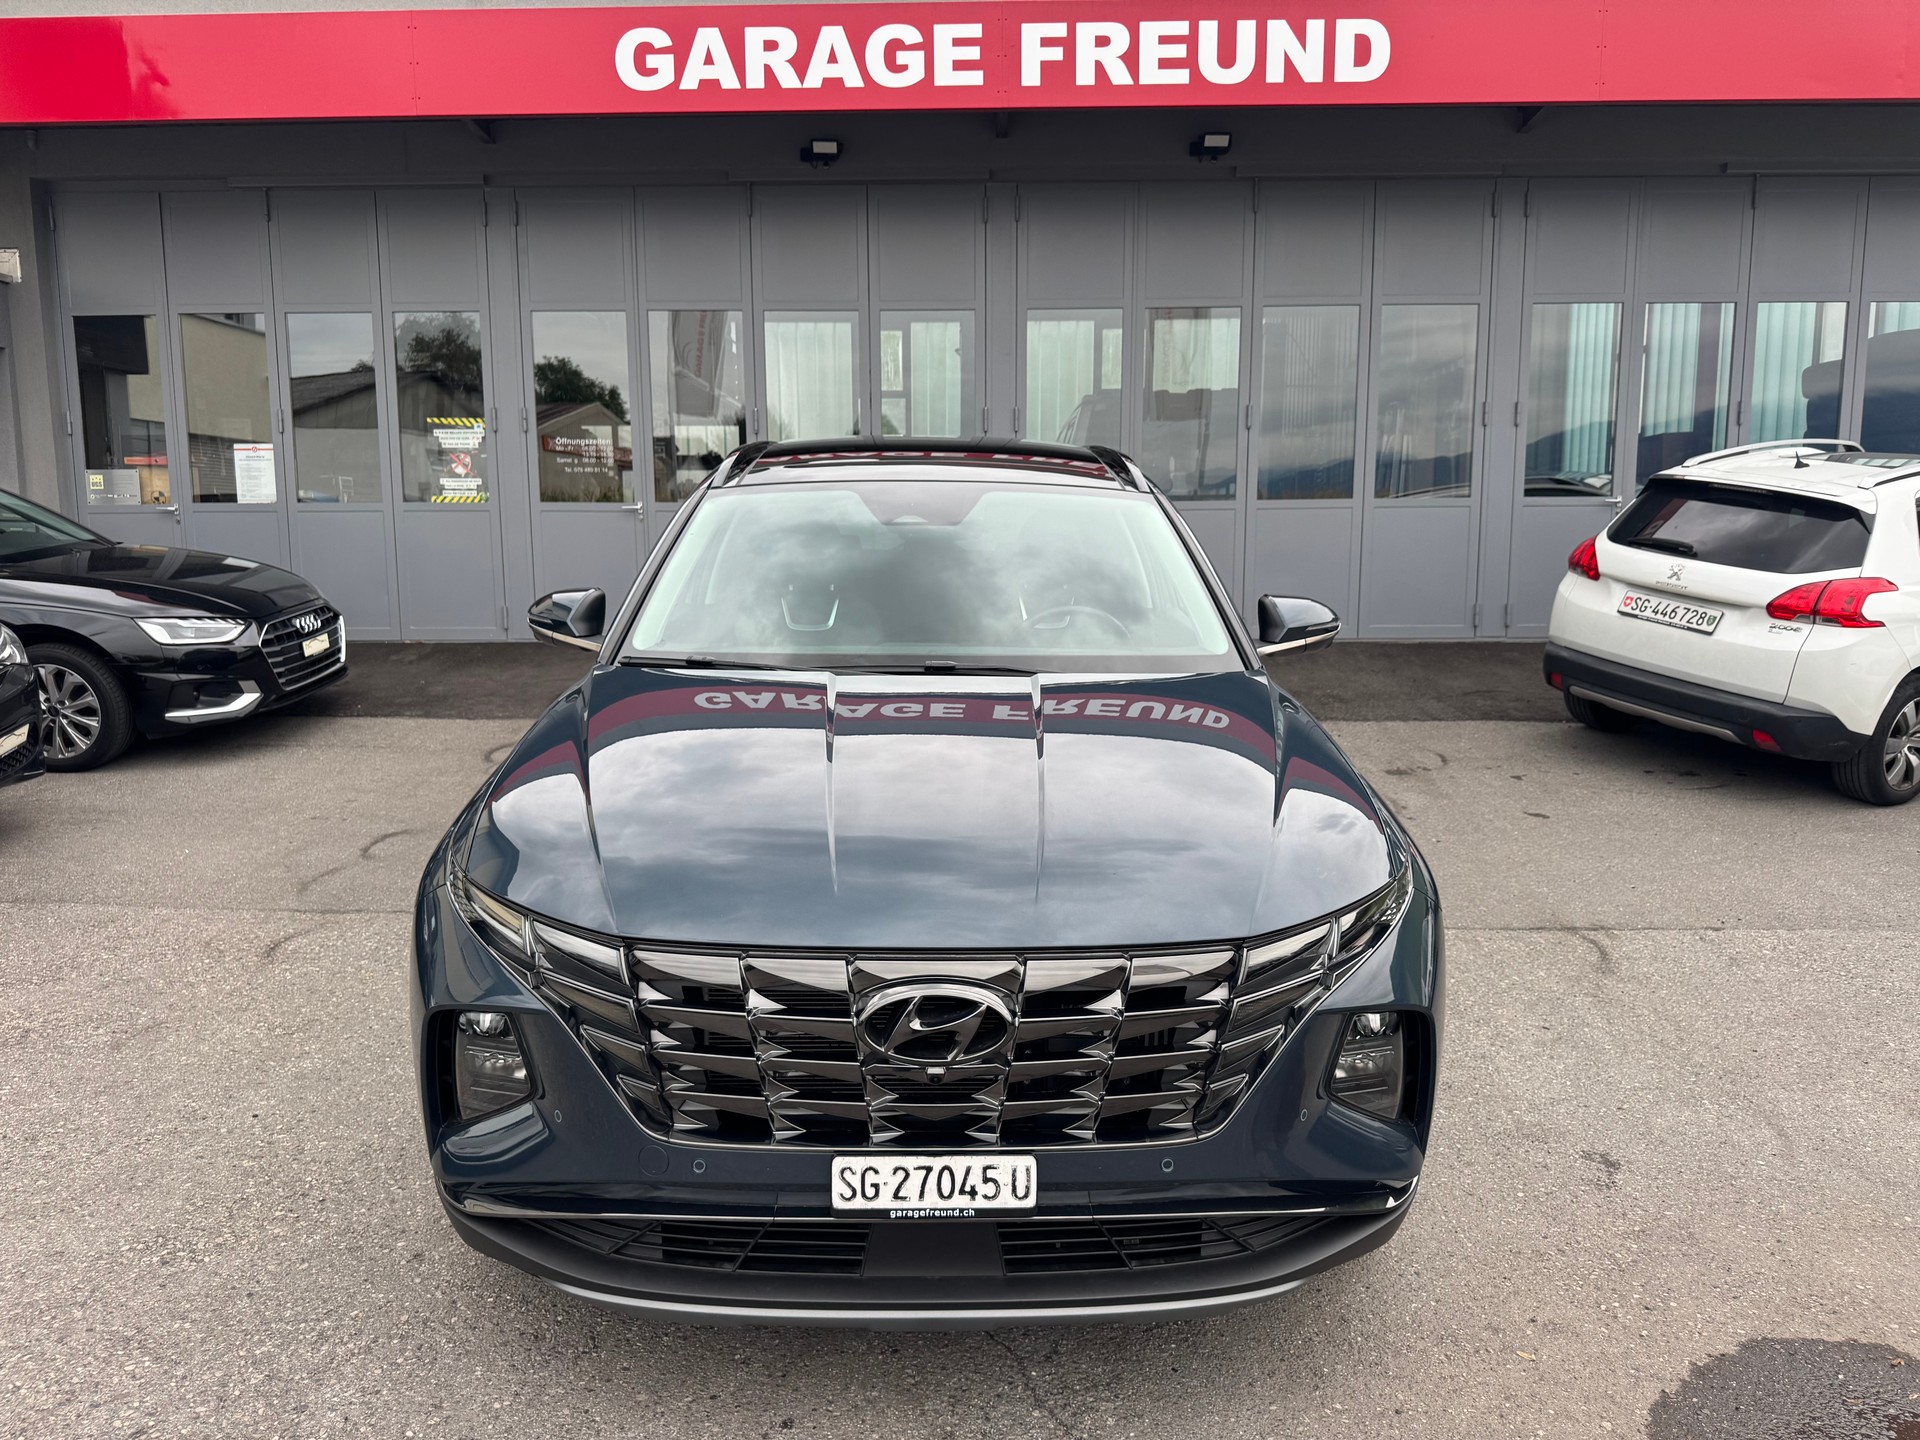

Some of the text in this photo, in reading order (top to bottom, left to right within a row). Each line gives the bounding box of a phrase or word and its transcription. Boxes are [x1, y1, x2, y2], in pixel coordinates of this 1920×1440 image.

[614, 17, 1392, 92] GARAGE FREUND
[889, 1208, 975, 1218] garagefreund.ch
